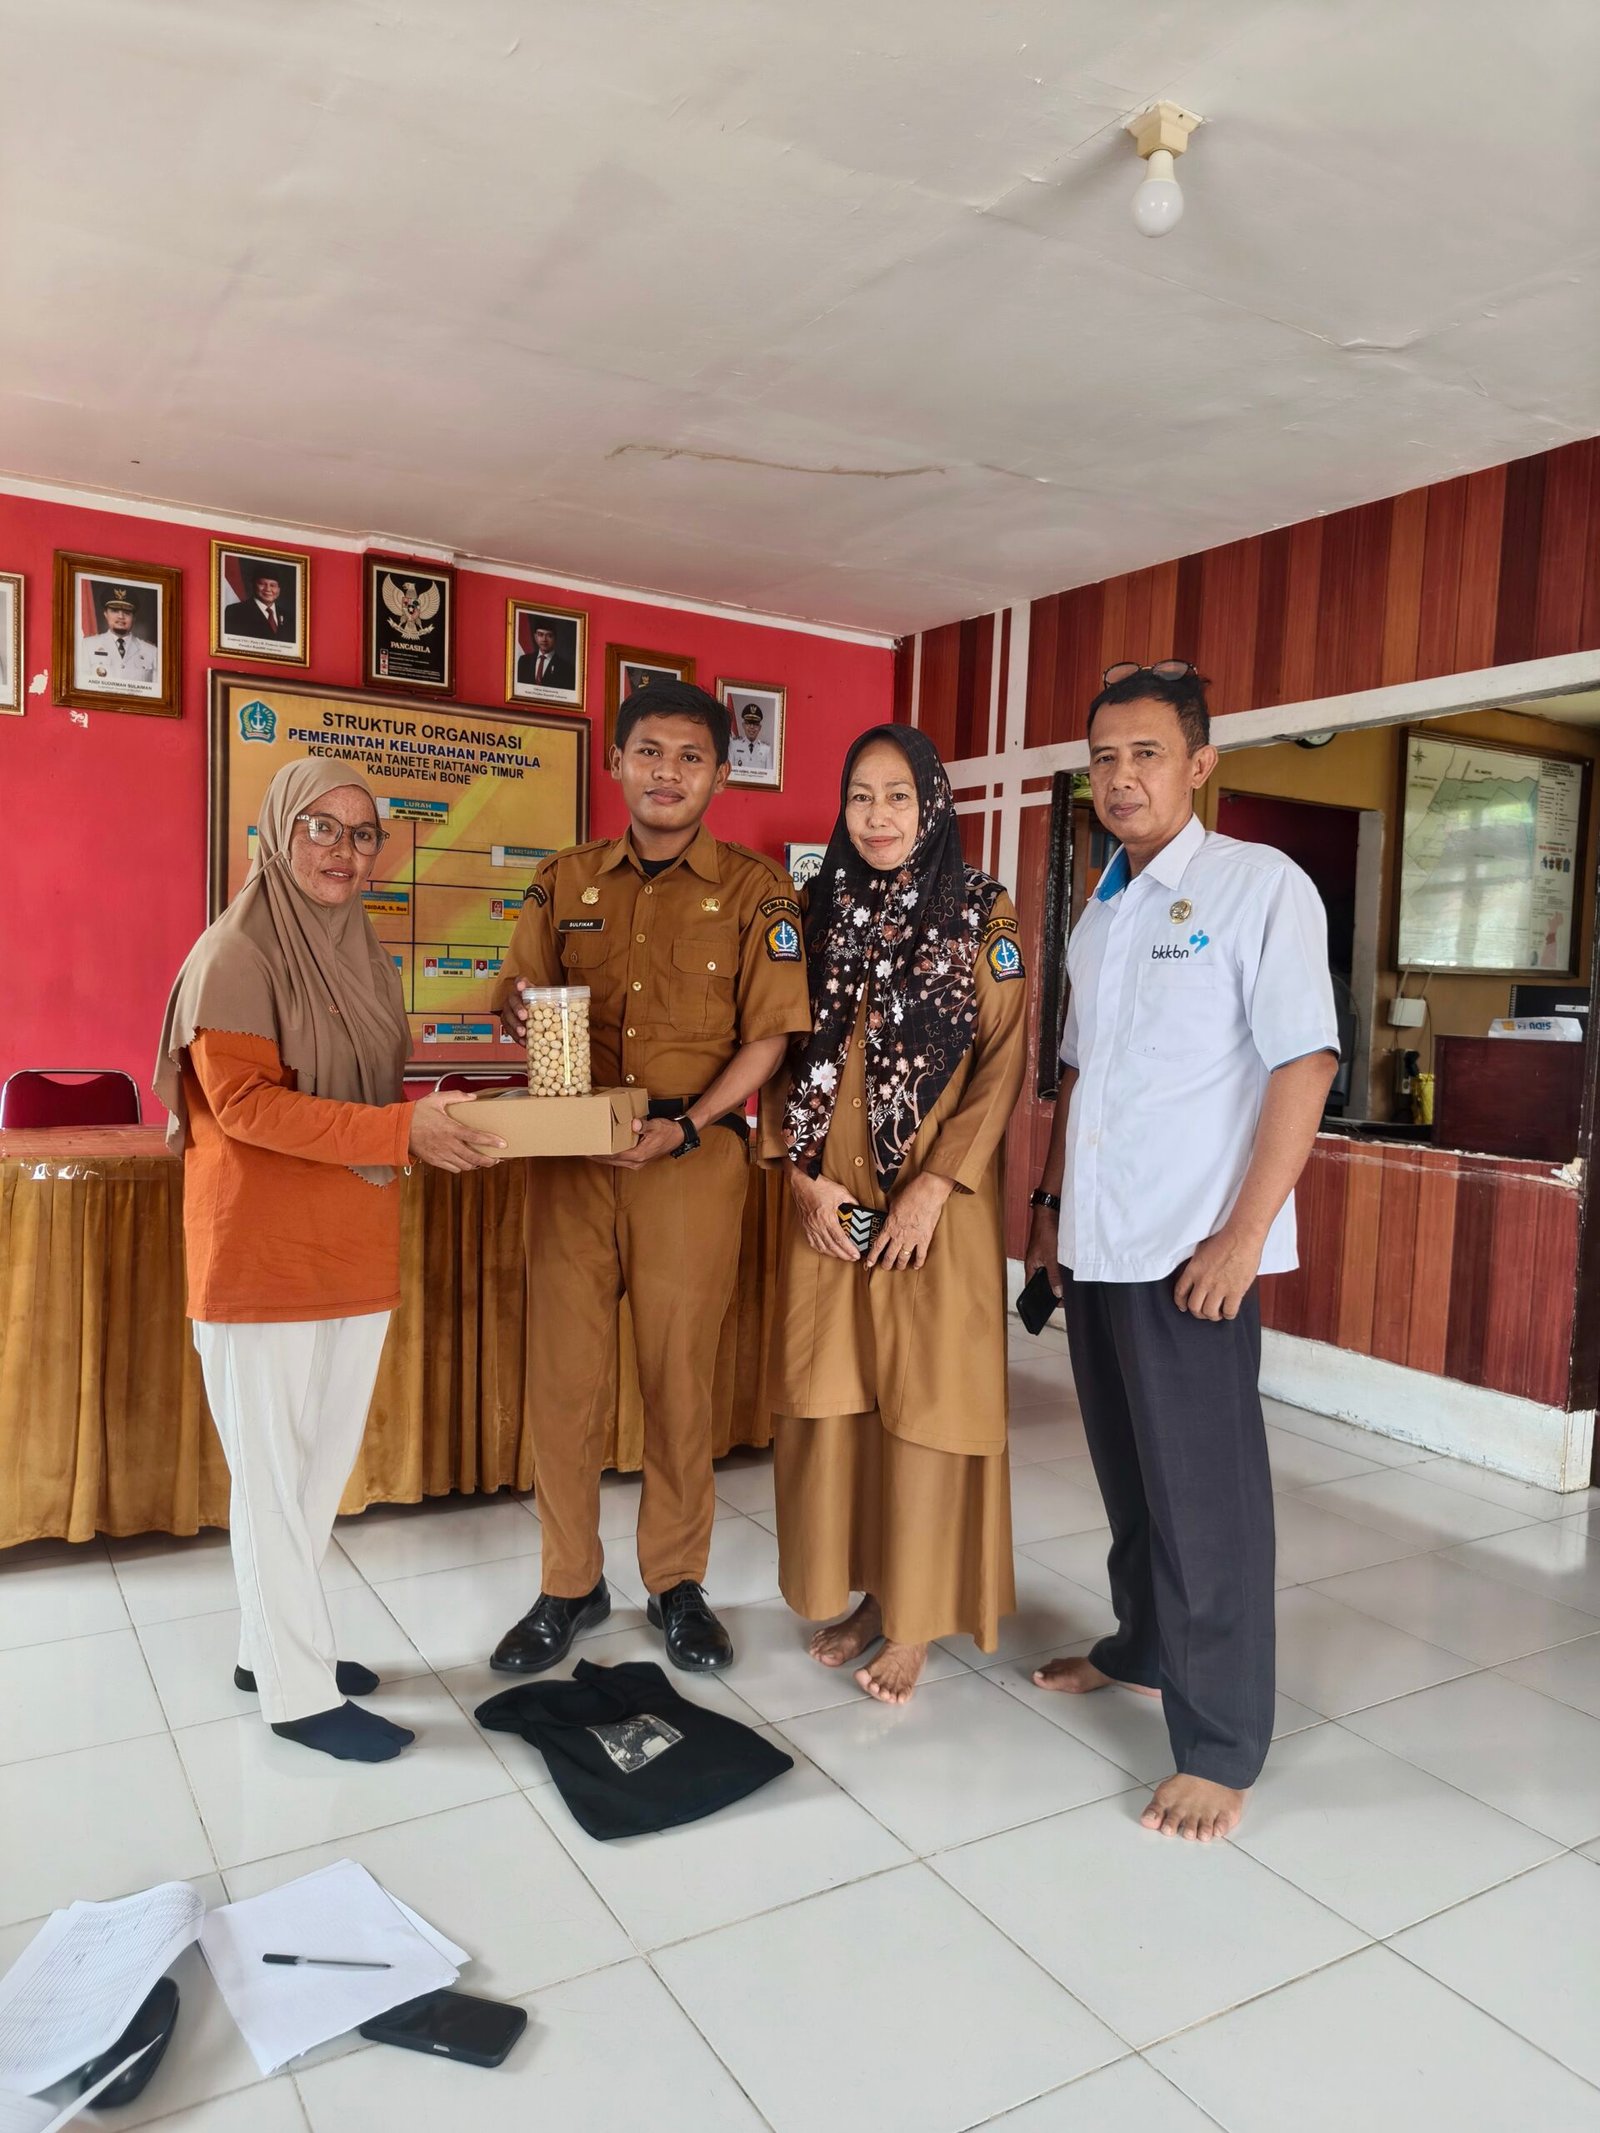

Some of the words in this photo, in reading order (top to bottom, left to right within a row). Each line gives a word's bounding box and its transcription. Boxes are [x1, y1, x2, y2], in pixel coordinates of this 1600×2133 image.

[390, 641, 431, 653] PANCASILA
[322, 712, 417, 737] STRUKTUR
[421, 724, 522, 750] ORGANISASI
[288, 728, 385, 750] PEMERINTAH
[389, 739, 476, 761] KELURAHAN
[479, 750, 541, 768] PANYULA
[308, 745, 382, 764] KECAMATAN
[386, 753, 430, 769] TANETE
[433, 759, 488, 776] RIATTANG
[491, 766, 524, 780] TIMUR
[367, 763, 437, 782] KABUPATEN
[439, 772, 471, 785] BONE
[404, 801, 432, 809] LURAH
[1151, 944, 1189, 959] bkkbn
[1529, 1022, 1552, 1030] SiDU
